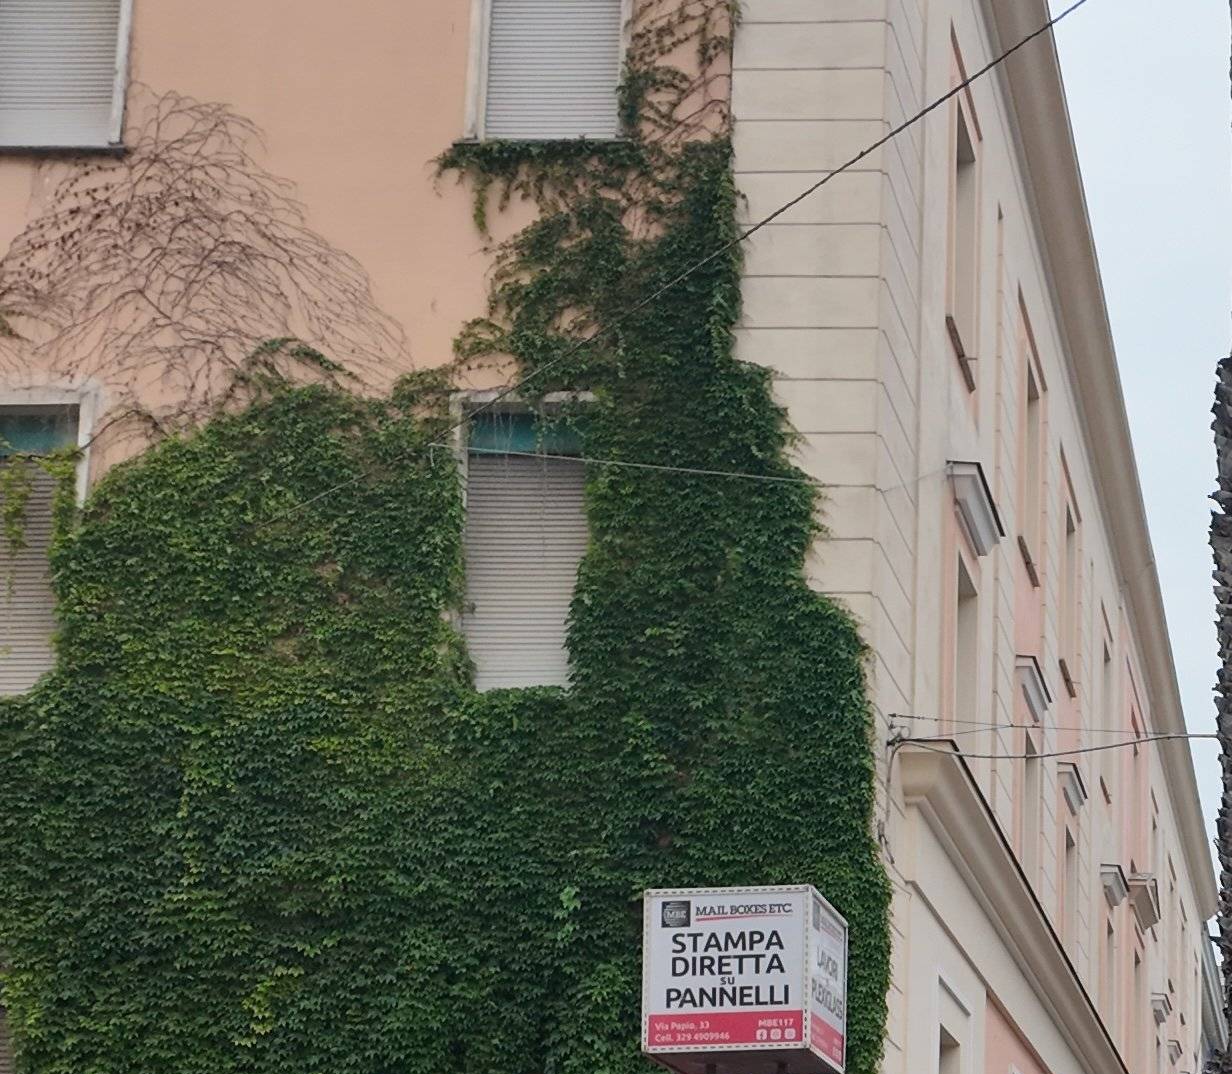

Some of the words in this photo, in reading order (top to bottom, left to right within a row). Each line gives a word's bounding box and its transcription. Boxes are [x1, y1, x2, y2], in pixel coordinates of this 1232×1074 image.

[695, 906, 728, 916] MAIL
[730, 904, 767, 915] BOXES
[671, 930, 785, 954] STAMPA
[671, 954, 786, 977] DIRETTA
[720, 977, 736, 985] SU
[665, 984, 790, 1009] PANNELLI
[654, 1022, 669, 1030] Via
